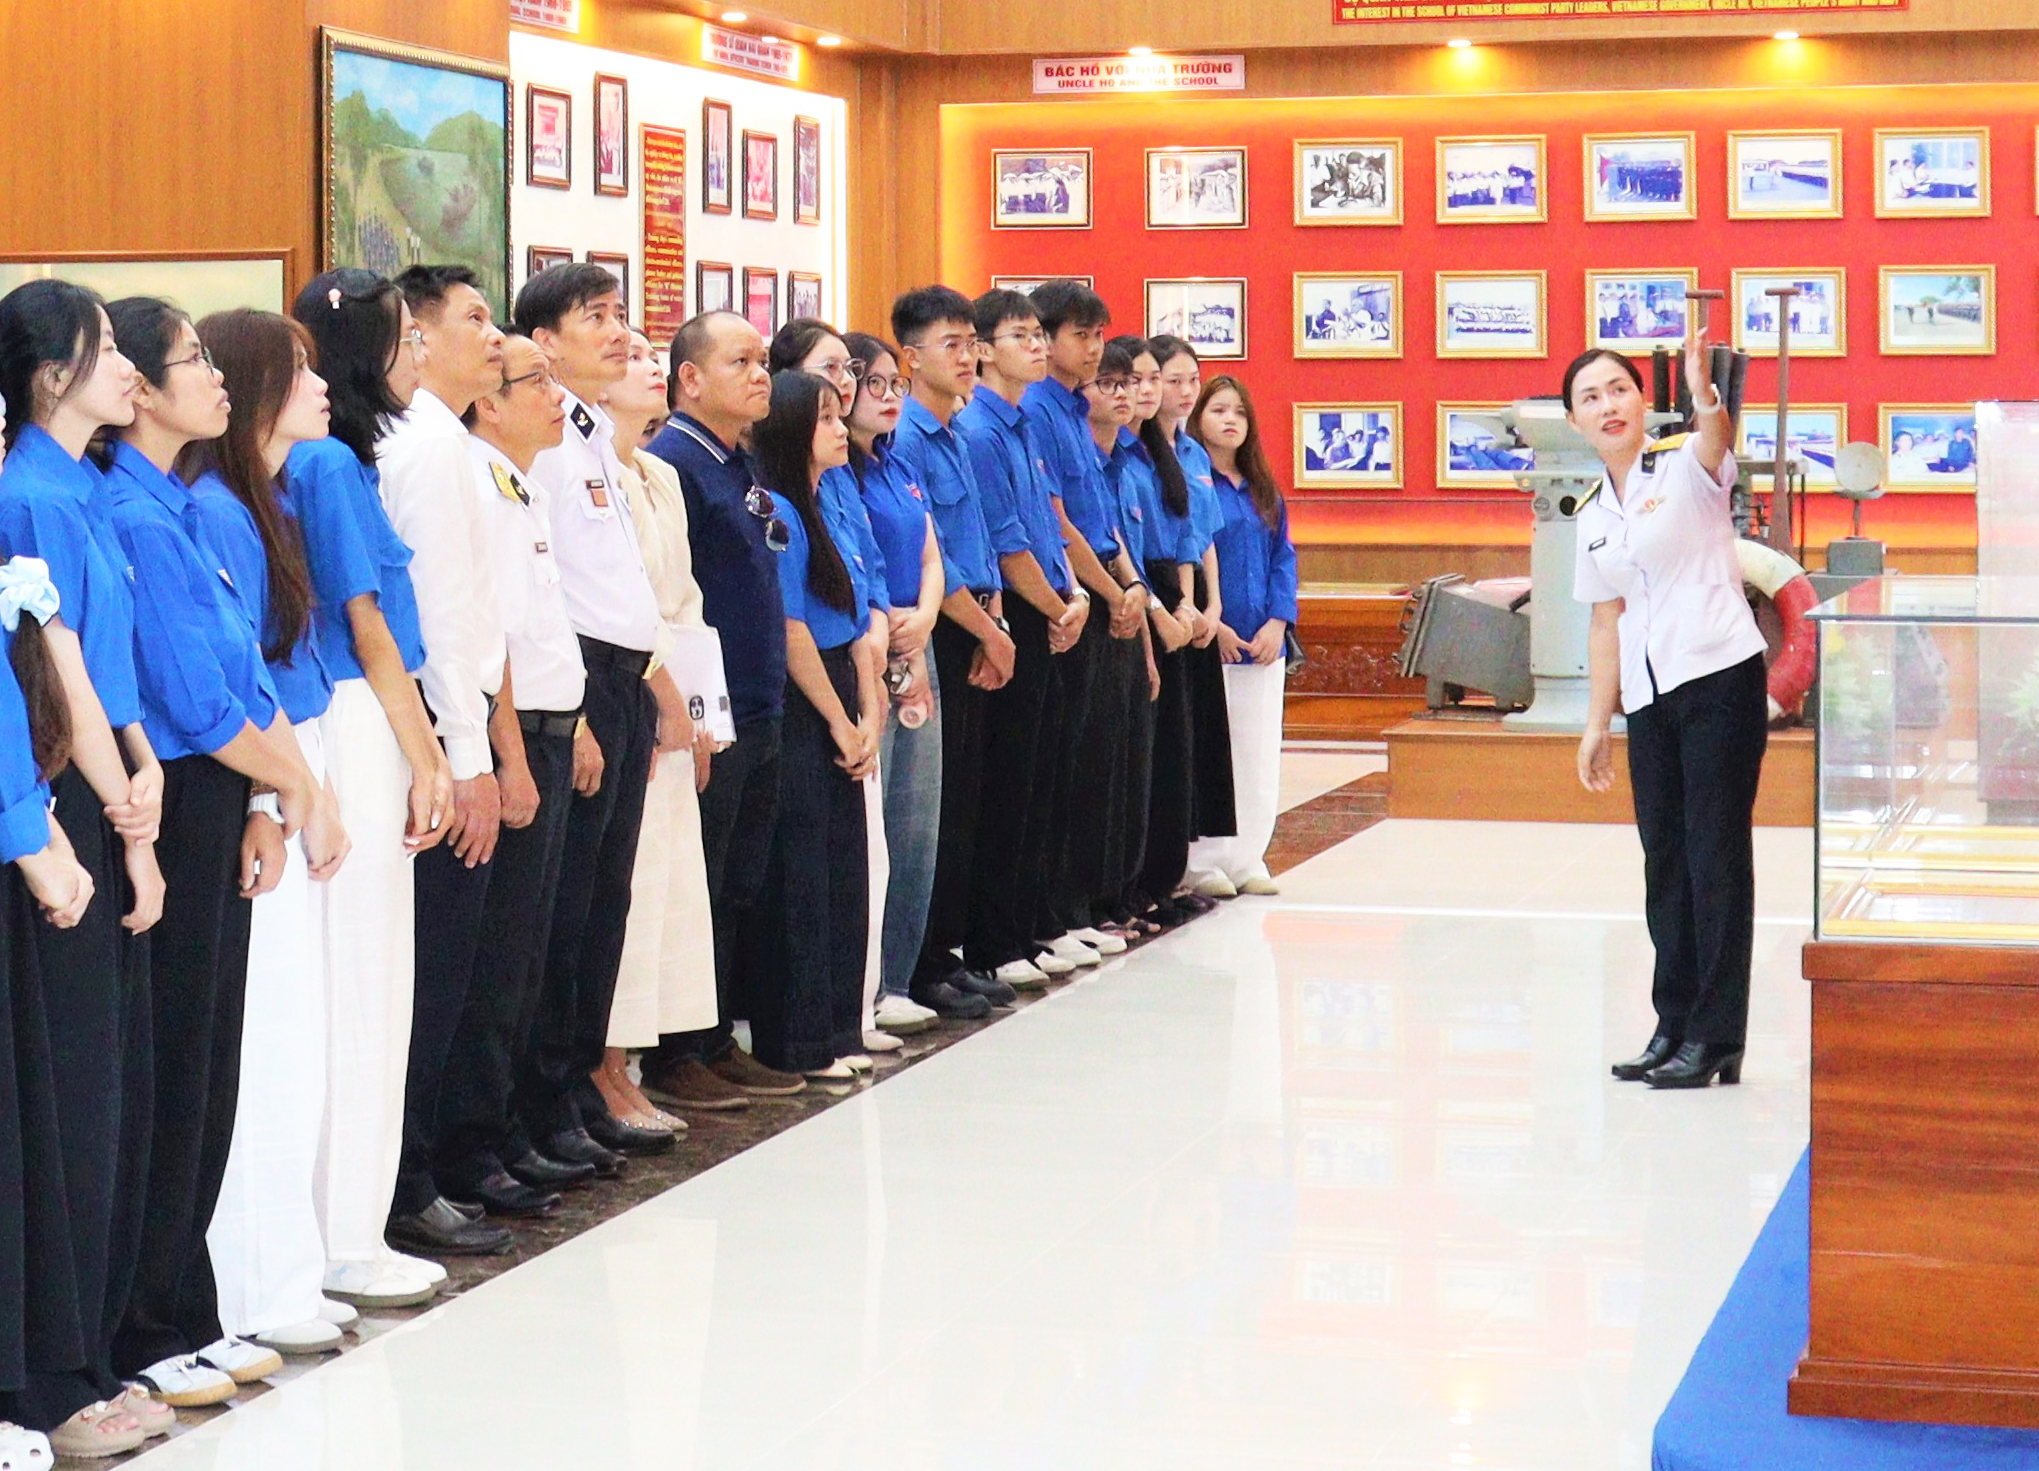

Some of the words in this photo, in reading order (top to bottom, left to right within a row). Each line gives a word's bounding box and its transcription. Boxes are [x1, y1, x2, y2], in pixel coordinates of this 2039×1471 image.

[1045, 64, 1075, 77] BÁC
[1058, 79, 1095, 88] UNCLE
[1099, 79, 1116, 88] HO
[1174, 76, 1219, 86] SCHOOL
